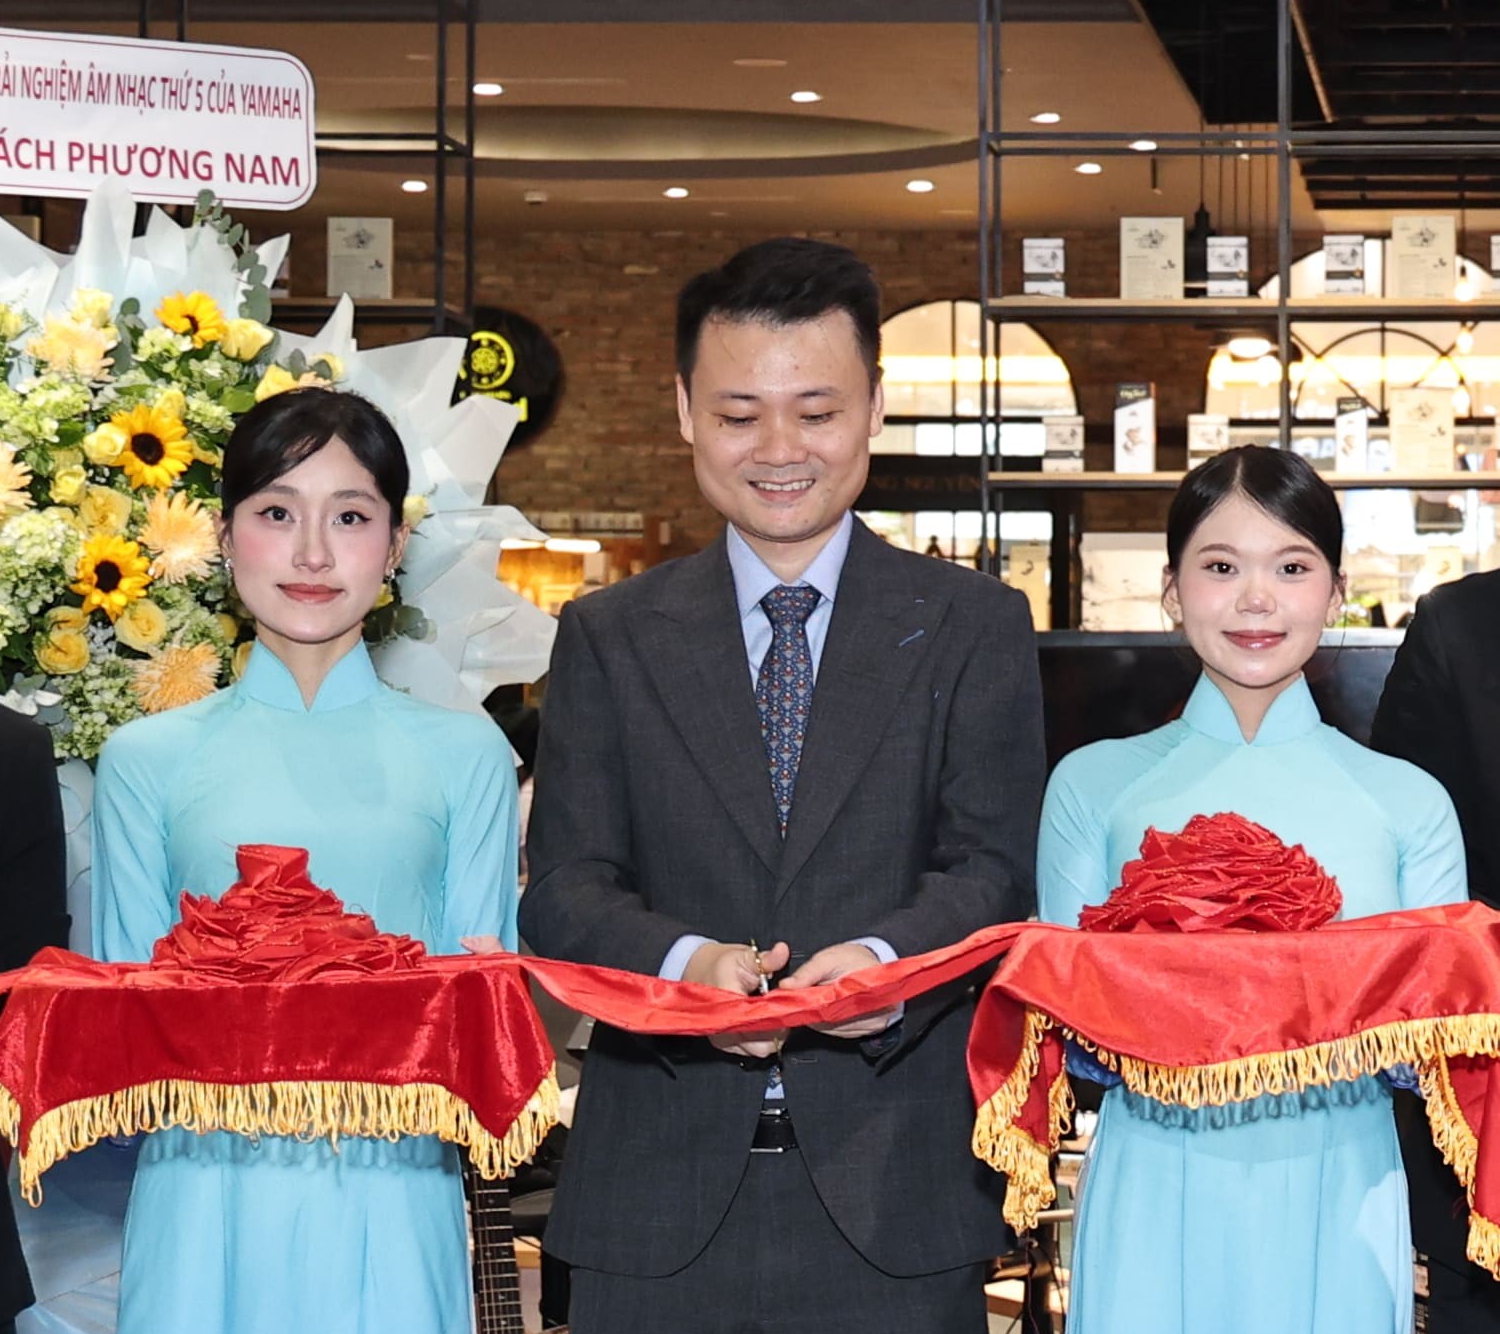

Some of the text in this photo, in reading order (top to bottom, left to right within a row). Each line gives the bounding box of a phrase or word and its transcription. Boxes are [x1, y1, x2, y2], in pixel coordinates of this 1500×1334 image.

[21, 59, 82, 110] NGHIỆM
[86, 65, 111, 105] ÂM
[115, 73, 156, 116] NHẠC
[160, 70, 193, 111] THỨ
[194, 80, 204, 113] 5
[207, 69, 237, 116] CỦA
[240, 83, 302, 121] YAMAHA
[67, 141, 214, 182] PHƯƠNG
[225, 152, 301, 187] NAM
